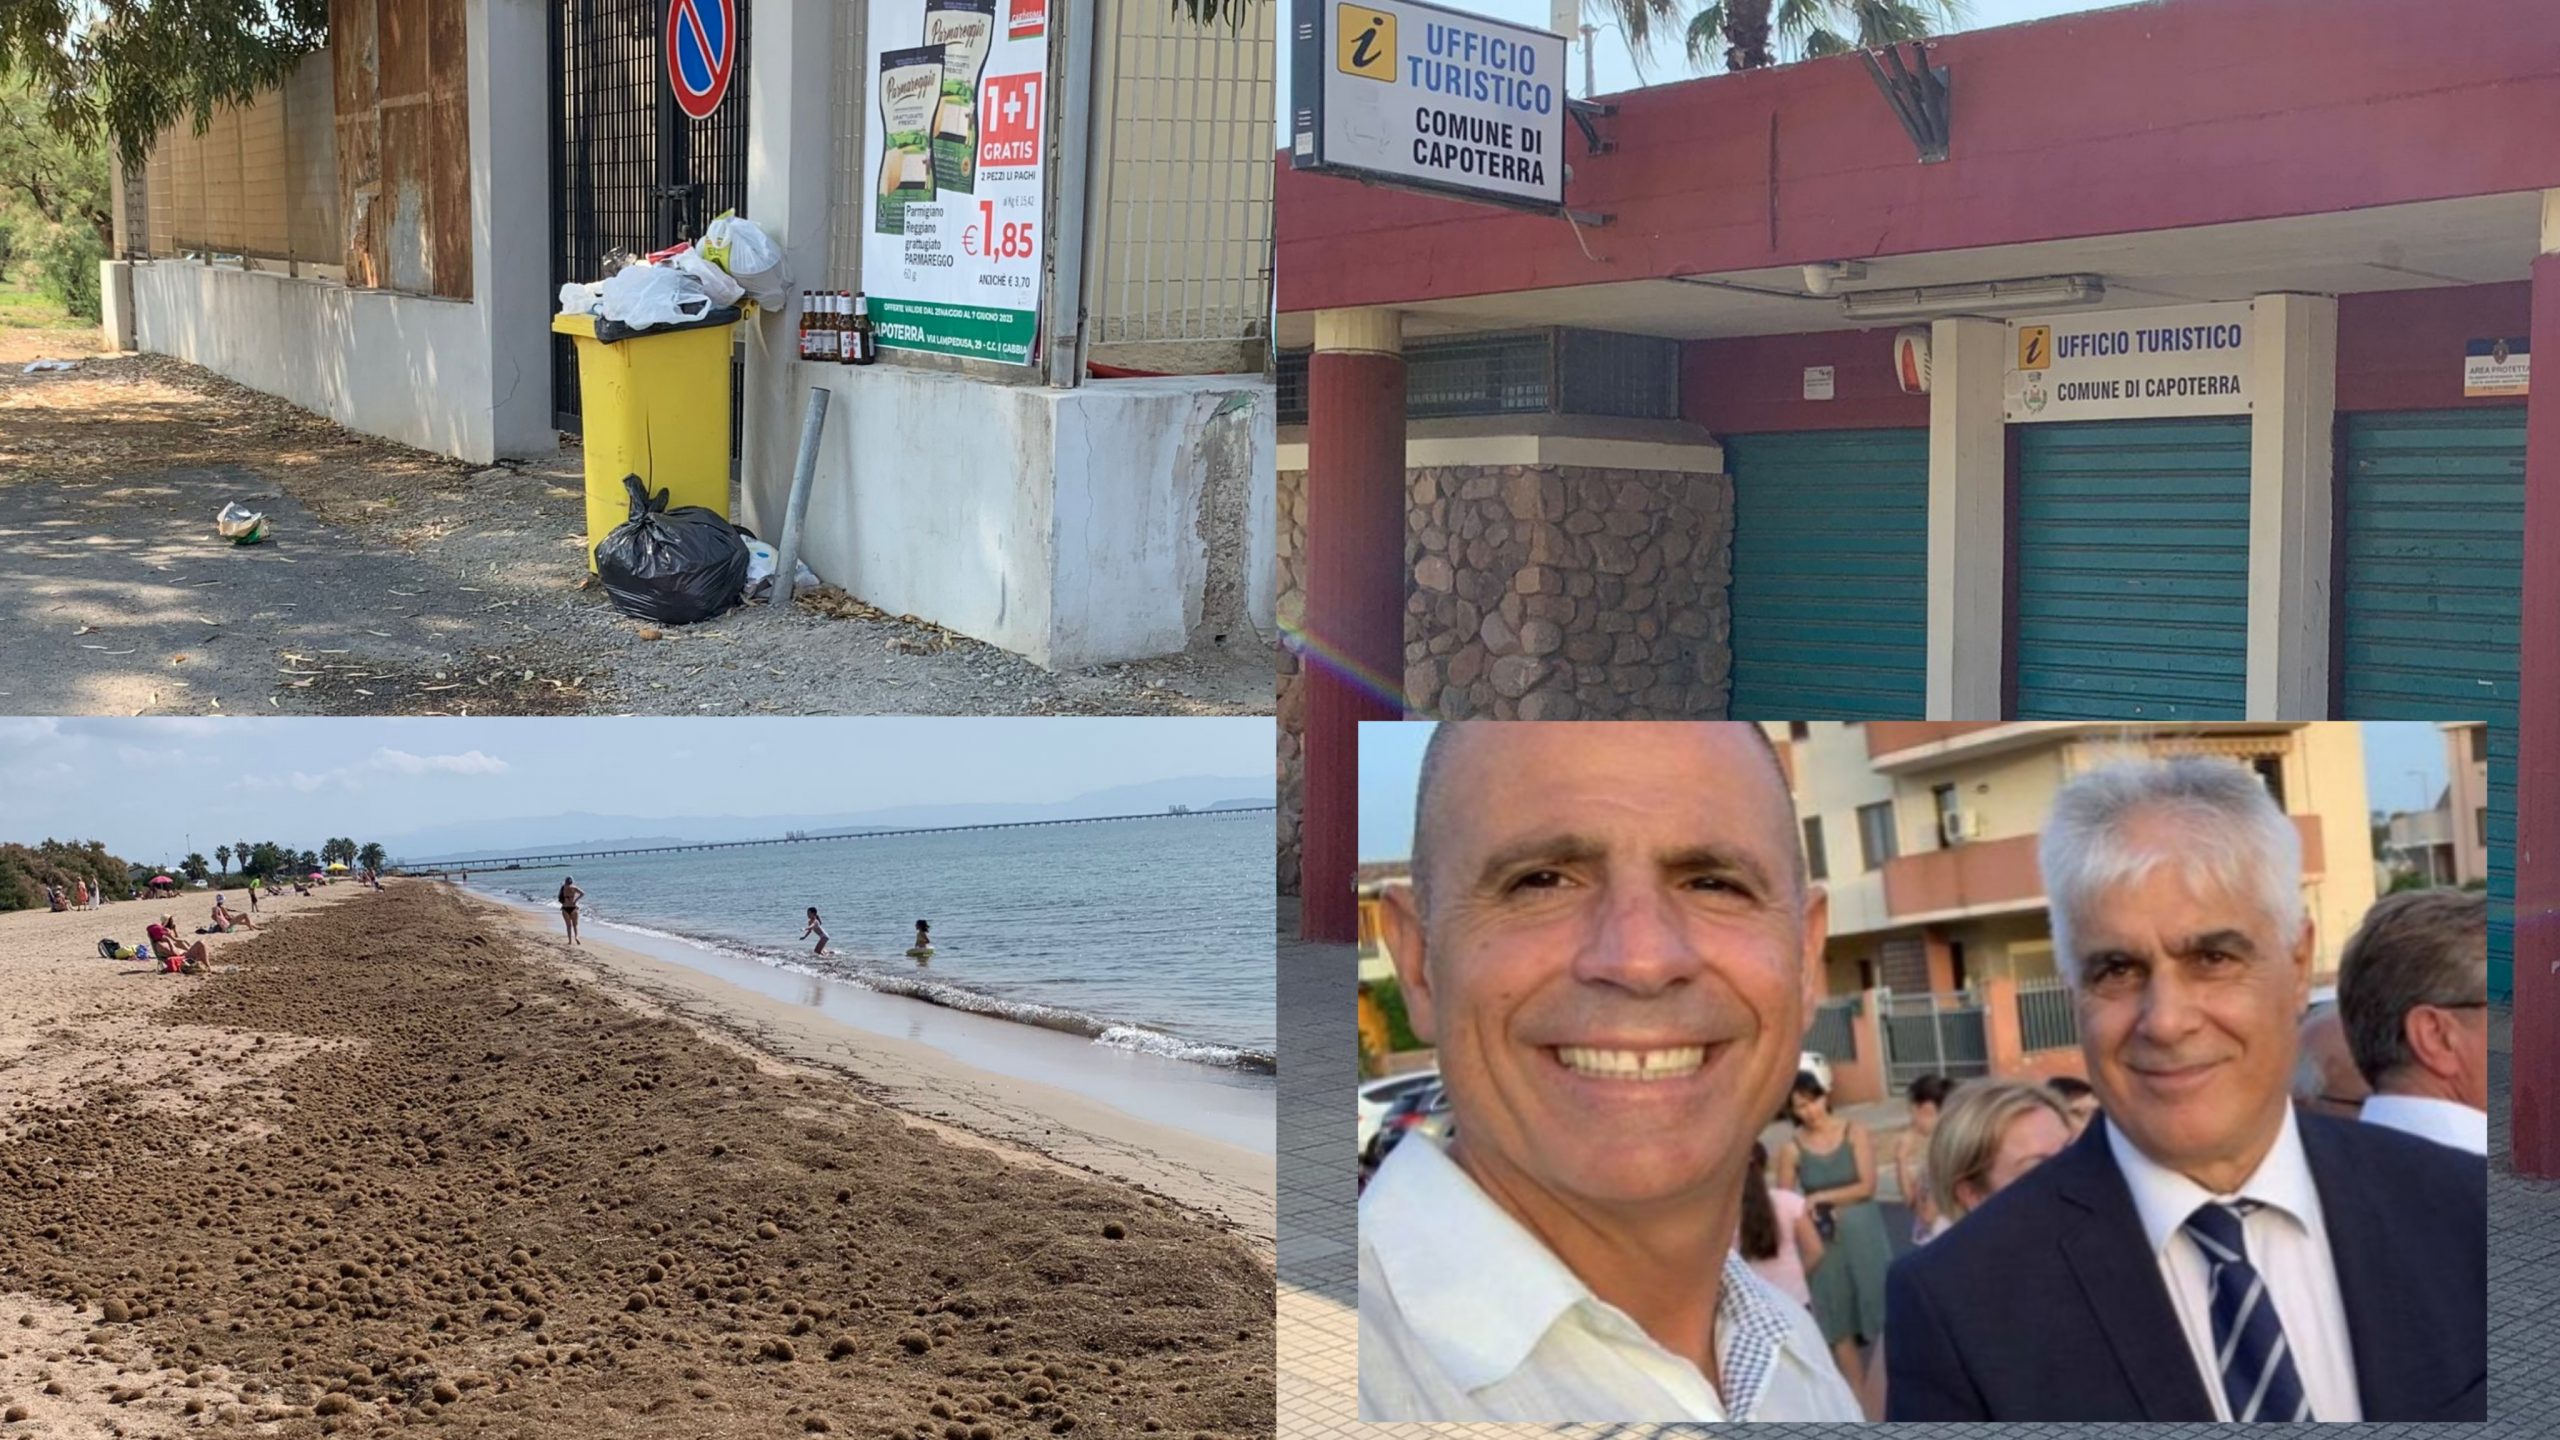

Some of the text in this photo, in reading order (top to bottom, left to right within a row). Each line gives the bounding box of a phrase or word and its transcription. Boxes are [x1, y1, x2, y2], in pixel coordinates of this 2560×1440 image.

[931, 18, 985, 48] Parmareggio
[1427, 23, 1536, 76] UFFICIO
[886, 70, 936, 104] Parmareggio
[1407, 55, 1551, 115] TURISTICO
[987, 81, 1037, 132] 1+1
[1416, 107, 1542, 154] COMUNE DI
[983, 141, 1033, 160] GRATIS
[1413, 138, 1544, 186] CAPOTERRA
[981, 171, 986, 181] 2
[986, 171, 1005, 181] PEZZI
[1014, 170, 1036, 180] PAGHI
[906, 204, 944, 219] Parmigiano
[905, 221, 937, 236] Reggiano
[905, 238, 942, 252] grattugiato
[1008, 275, 1013, 287] €
[1014, 276, 1031, 288] 3,70
[883, 302, 904, 312] OFFERTE
[905, 304, 923, 314] VALIDE
[923, 306, 934, 315] DAL
[963, 310, 971, 319] AL
[971, 311, 976, 319] 7
[976, 311, 999, 322] GIUGNO
[926, 334, 936, 343] VIA
[936, 335, 974, 350] LAMPEDUSA,
[2057, 324, 2242, 358] UFFICIO TURISTICO
[2057, 375, 2241, 401] COMUNE DI CAPOTERRA
